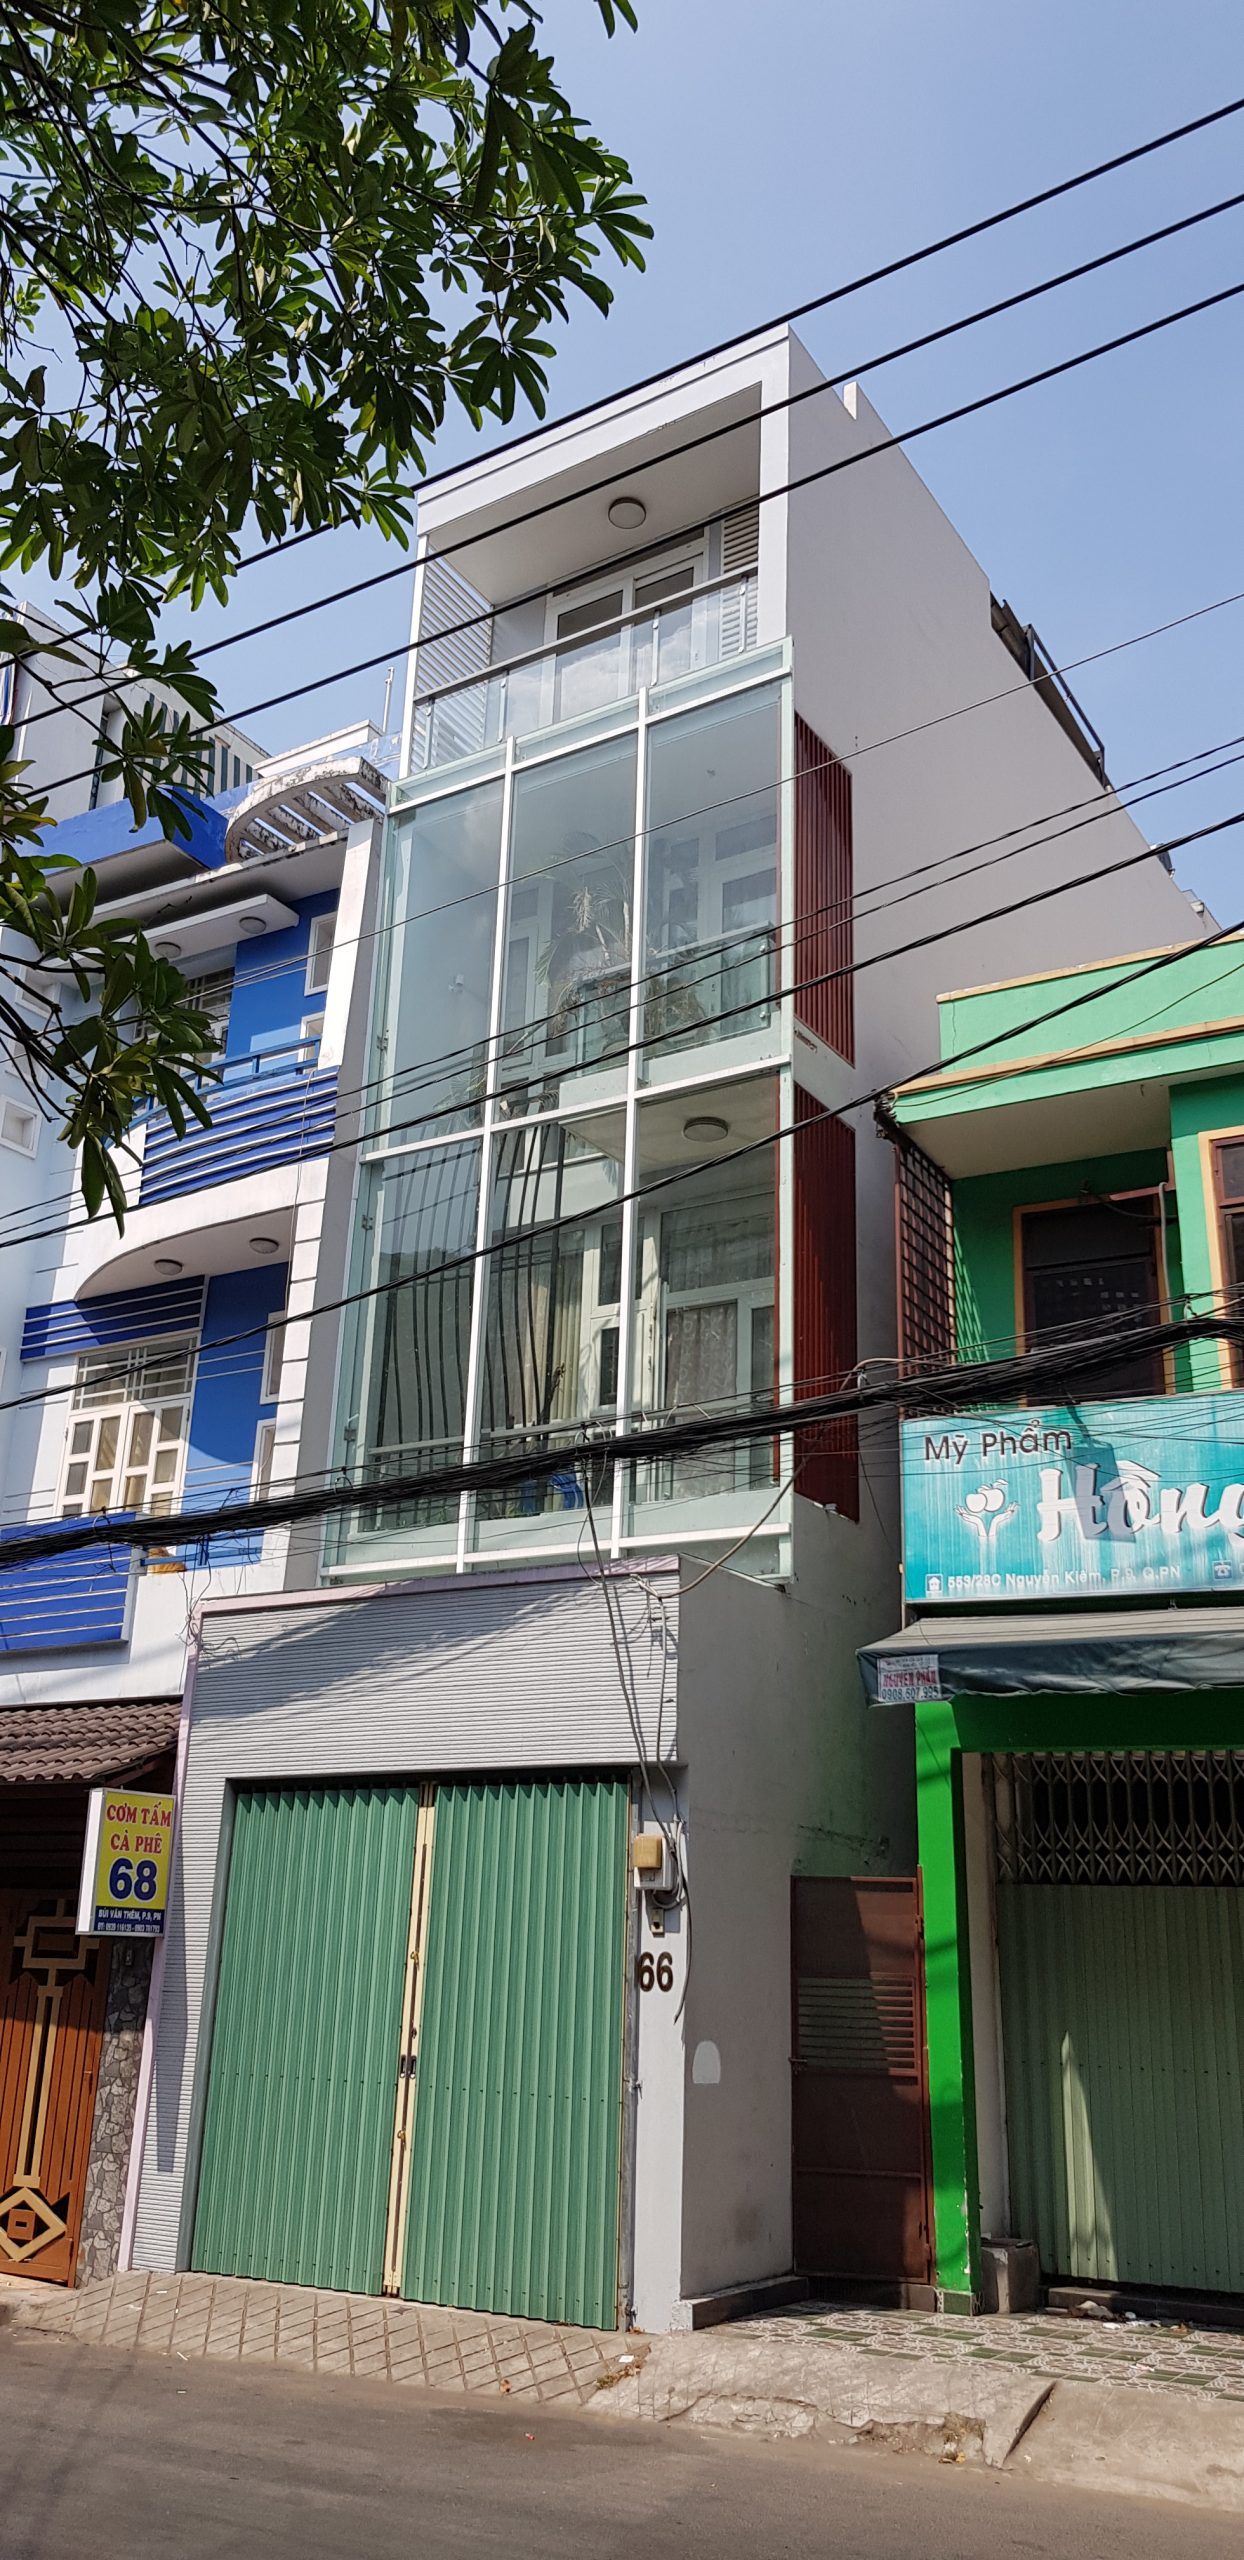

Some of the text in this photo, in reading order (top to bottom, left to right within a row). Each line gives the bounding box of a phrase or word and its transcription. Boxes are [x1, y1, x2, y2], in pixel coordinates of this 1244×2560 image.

[925, 1420, 1072, 1465] Mỹ Phẩm
[106, 1801, 172, 1827] CƠM TẤM
[110, 1829, 163, 1854] CÀ PHÊ
[109, 1857, 158, 1901] 68
[638, 1951, 674, 1993] 66
